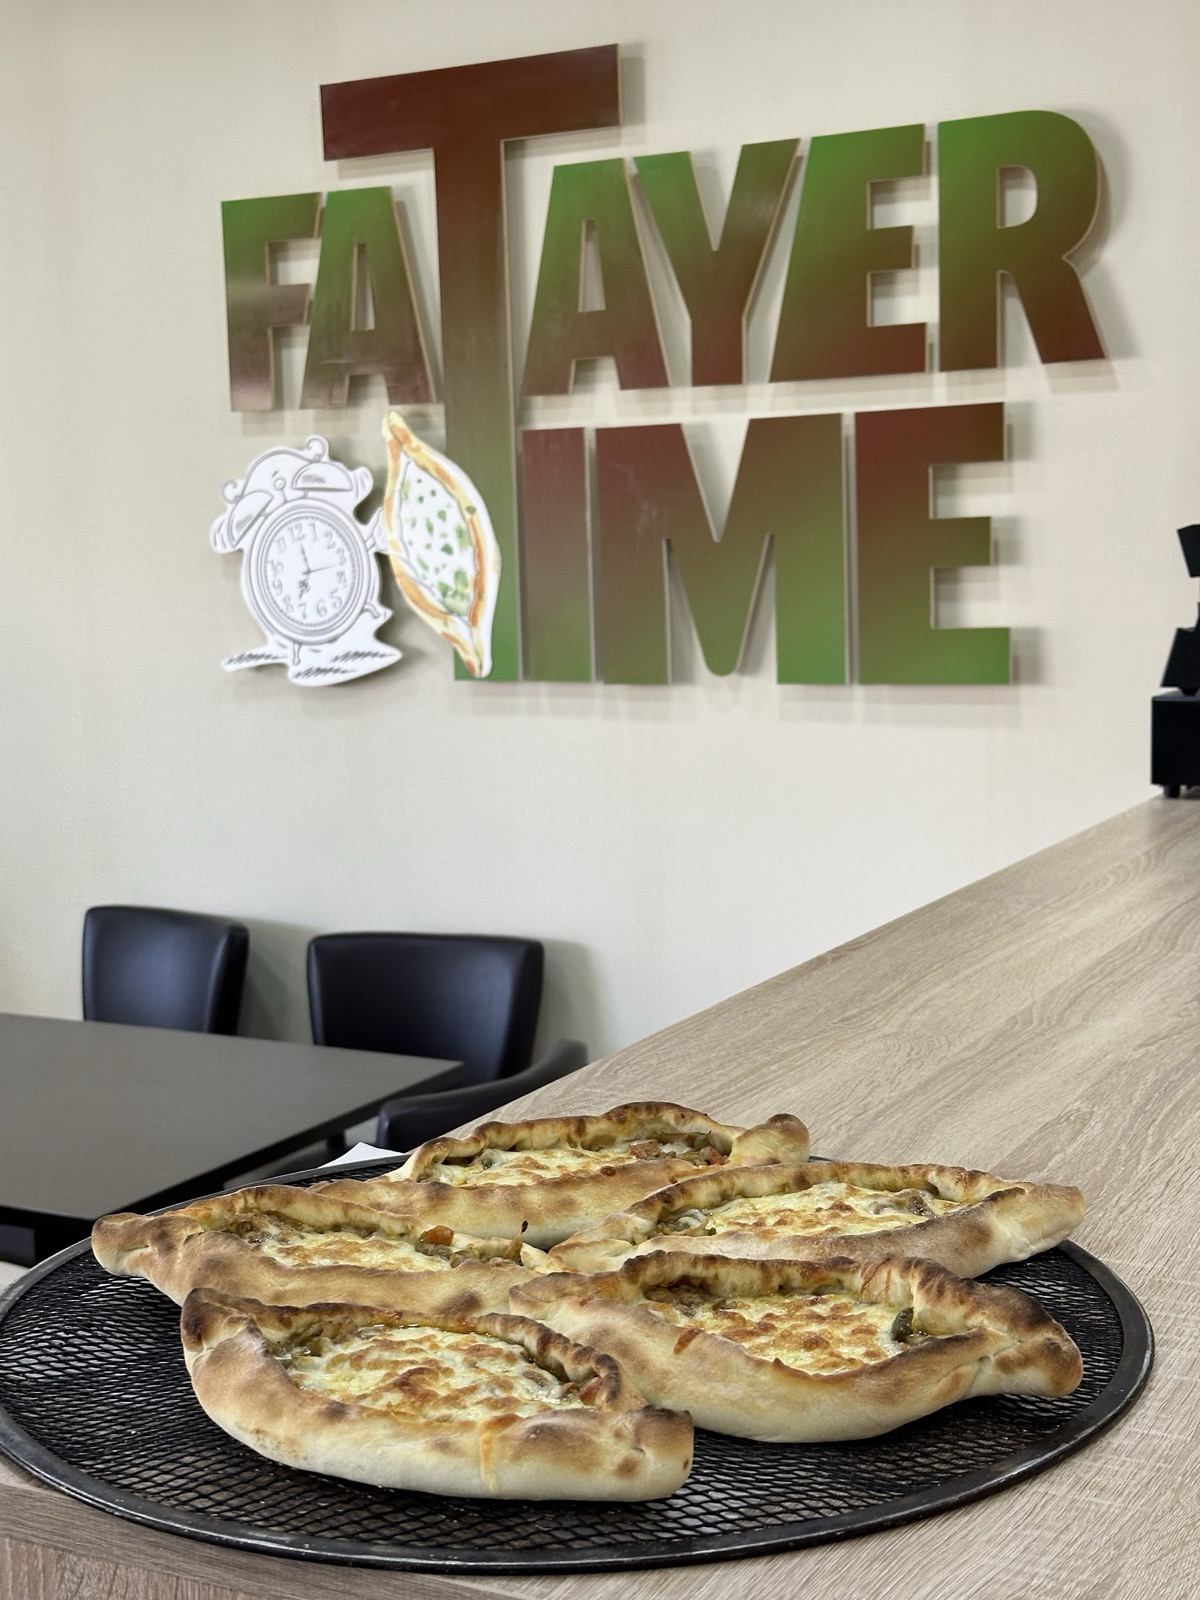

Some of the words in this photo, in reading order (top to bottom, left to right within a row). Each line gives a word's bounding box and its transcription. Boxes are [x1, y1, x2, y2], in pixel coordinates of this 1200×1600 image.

[221, 43, 1106, 413] FATAYER
[287, 523, 306, 542] 12
[324, 530, 337, 549] 2
[317, 599, 328, 617] 6
